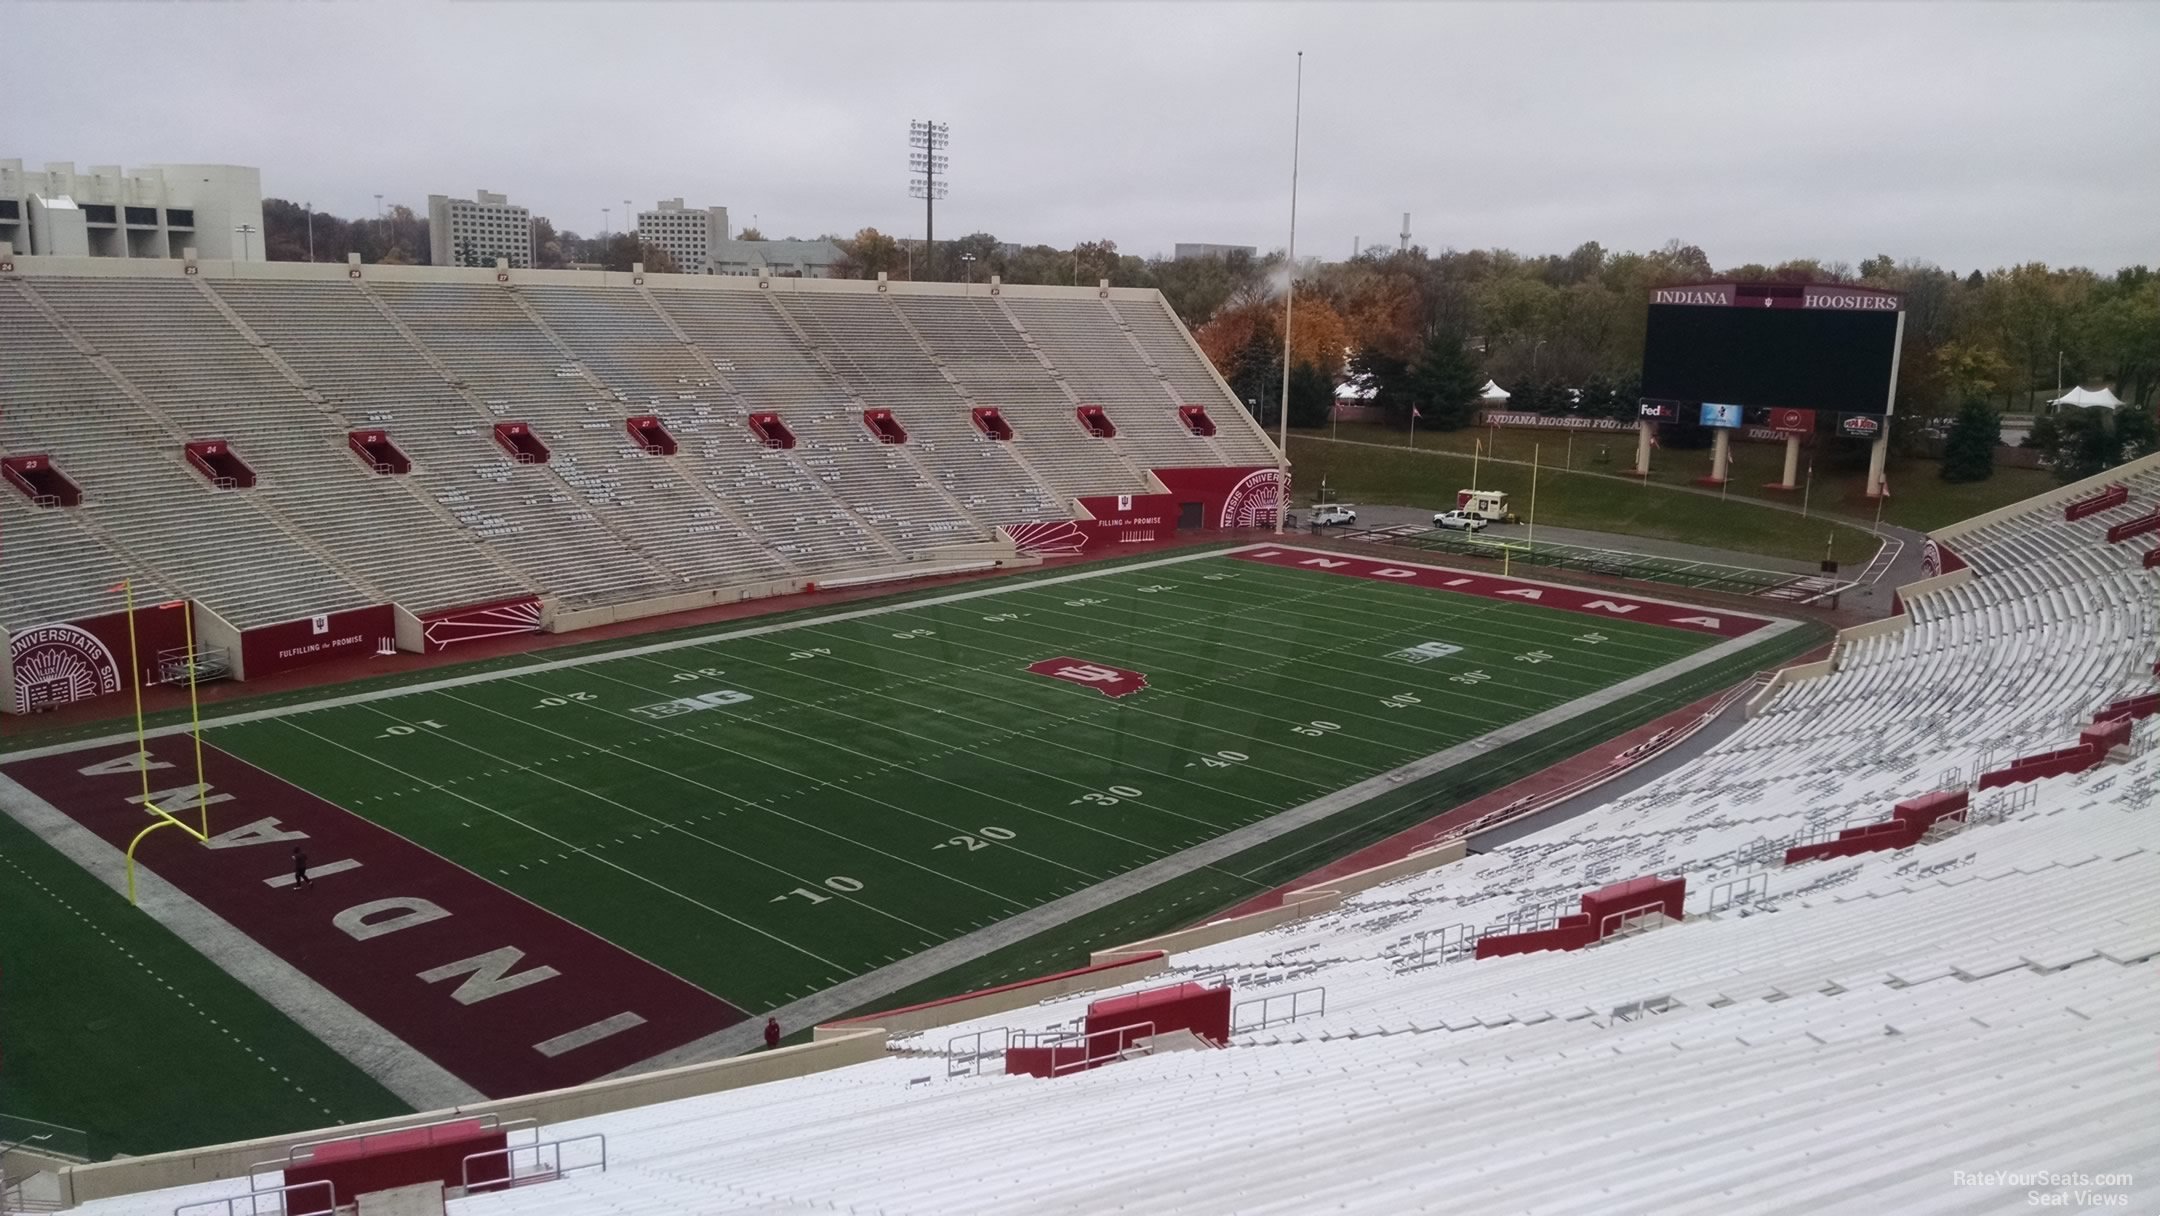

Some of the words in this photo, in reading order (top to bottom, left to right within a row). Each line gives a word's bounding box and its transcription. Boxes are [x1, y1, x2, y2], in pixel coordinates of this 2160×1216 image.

[1656, 290, 1728, 305] INDIANA
[1805, 294, 1898, 310] HOOSIERS
[1641, 404, 1673, 417] FedEx
[1487, 414, 1537, 425] INDIANA
[1539, 416, 1592, 428] HOOSIER
[1133, 516, 1161, 525] PROMISE
[279, 643, 320, 659] FULFILLING
[332, 634, 364, 648] PROMISE
[1572, 633, 1609, 646] 10
[1513, 650, 1554, 664] 20
[40, 666, 56, 676] LUX
[1448, 671, 1492, 686] 30
[539, 690, 599, 708] 20
[1380, 693, 1422, 709] 40
[1290, 719, 1342, 738] 50
[1200, 749, 1250, 769] 40
[1082, 784, 1143, 807] 30
[948, 825, 1017, 852] 20
[788, 875, 865, 905] 10
